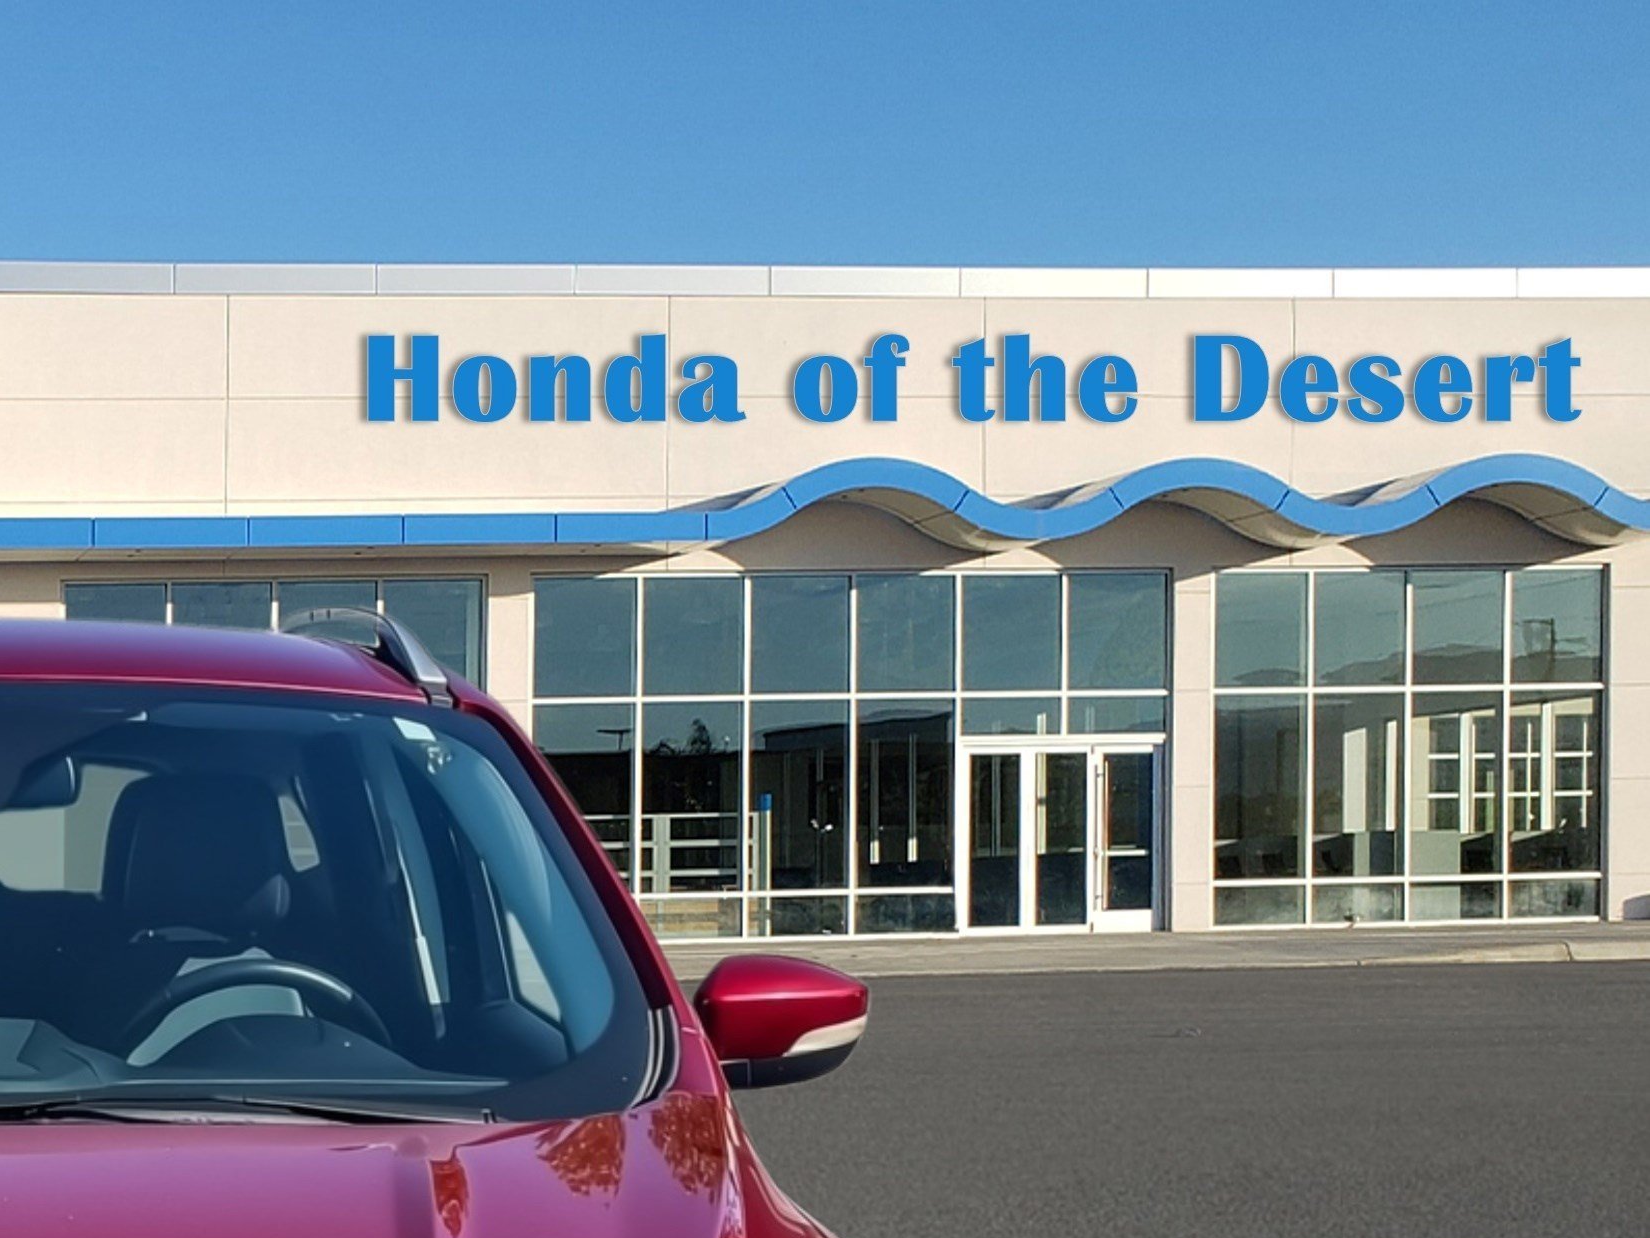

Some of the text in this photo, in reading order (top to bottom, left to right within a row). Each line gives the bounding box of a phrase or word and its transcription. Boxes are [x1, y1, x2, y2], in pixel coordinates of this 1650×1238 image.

[366, 333, 1582, 423] Honda of the Desert
